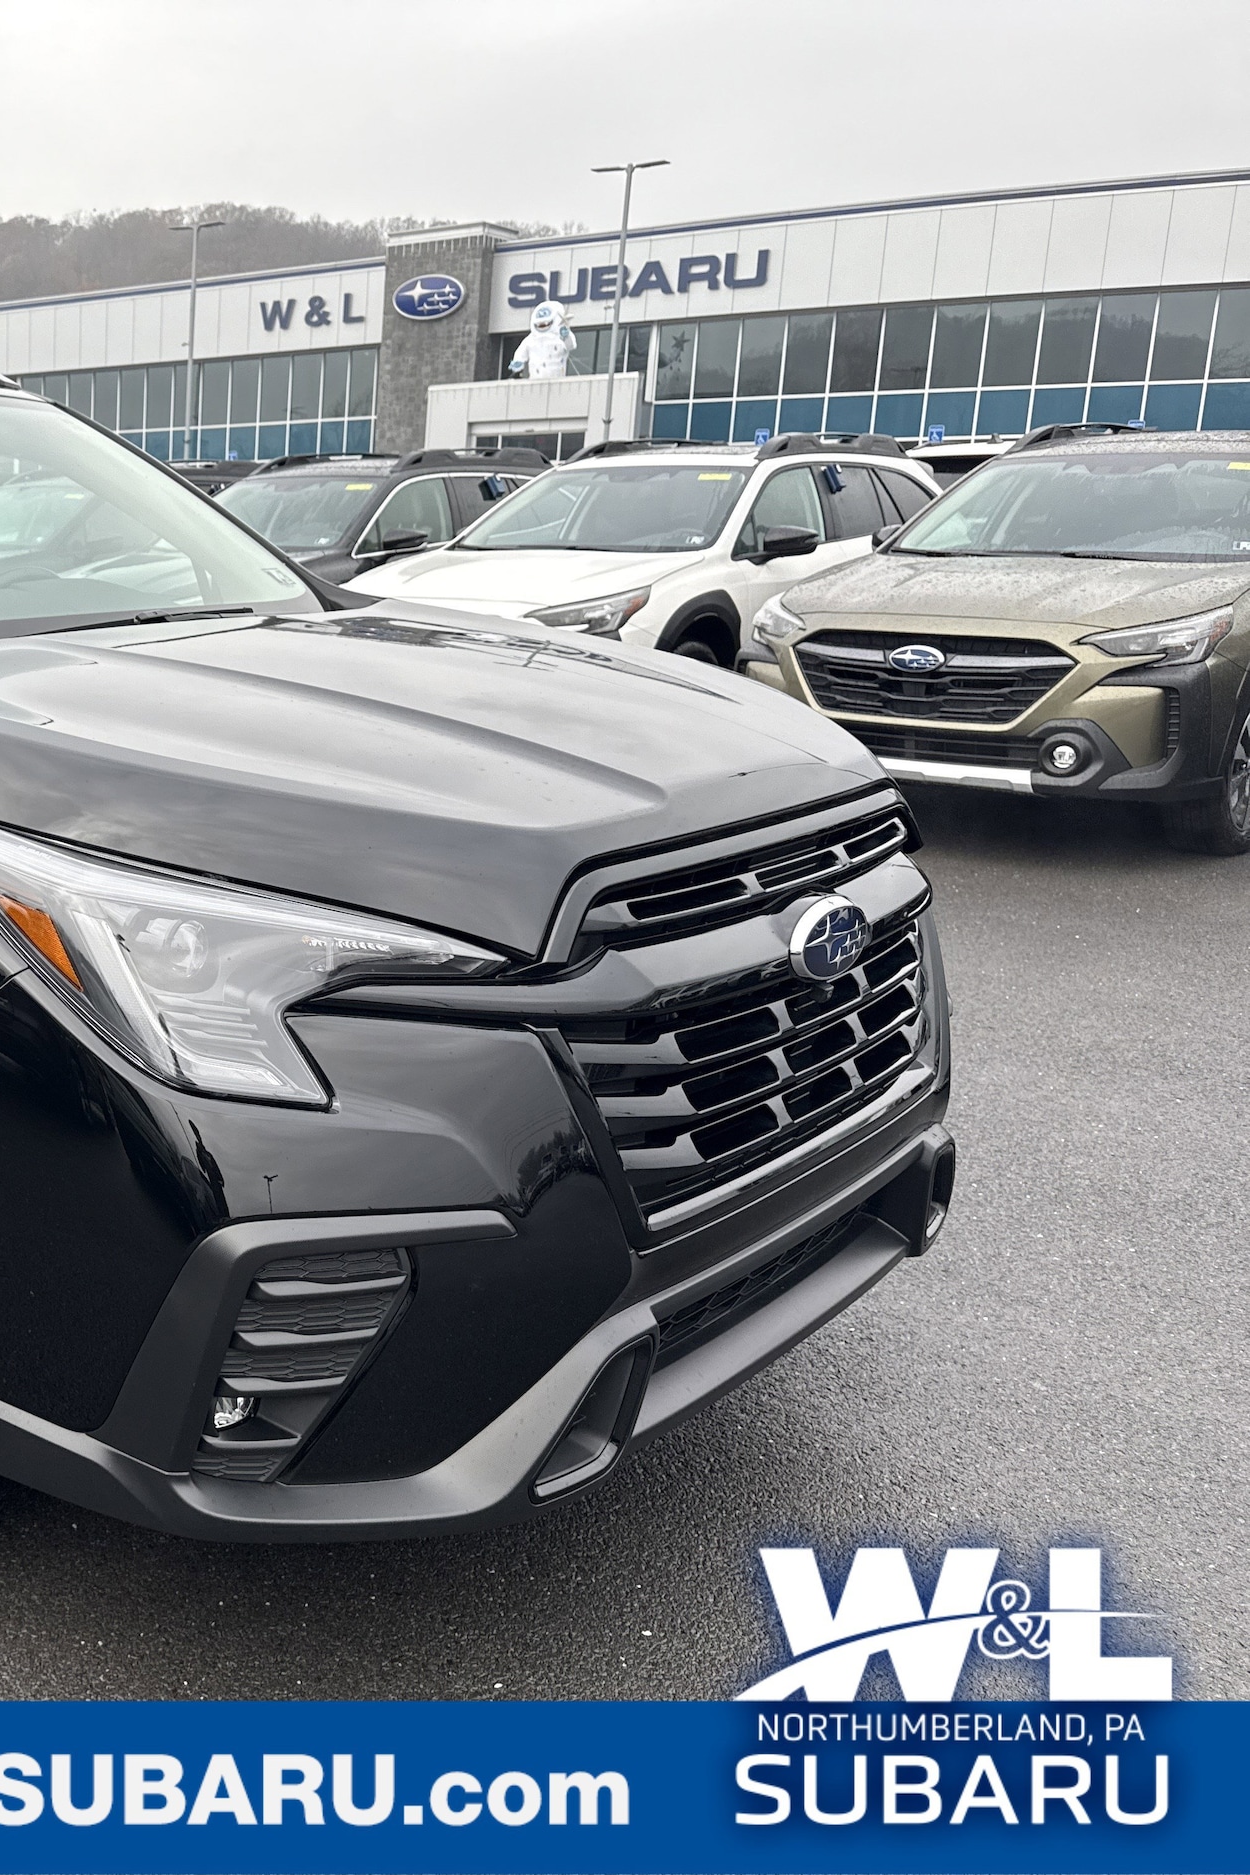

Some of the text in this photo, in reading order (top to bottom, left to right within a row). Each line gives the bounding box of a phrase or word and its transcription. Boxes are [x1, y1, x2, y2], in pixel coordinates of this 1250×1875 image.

[507, 248, 770, 309] SUBARU
[260, 292, 365, 332] W & L
